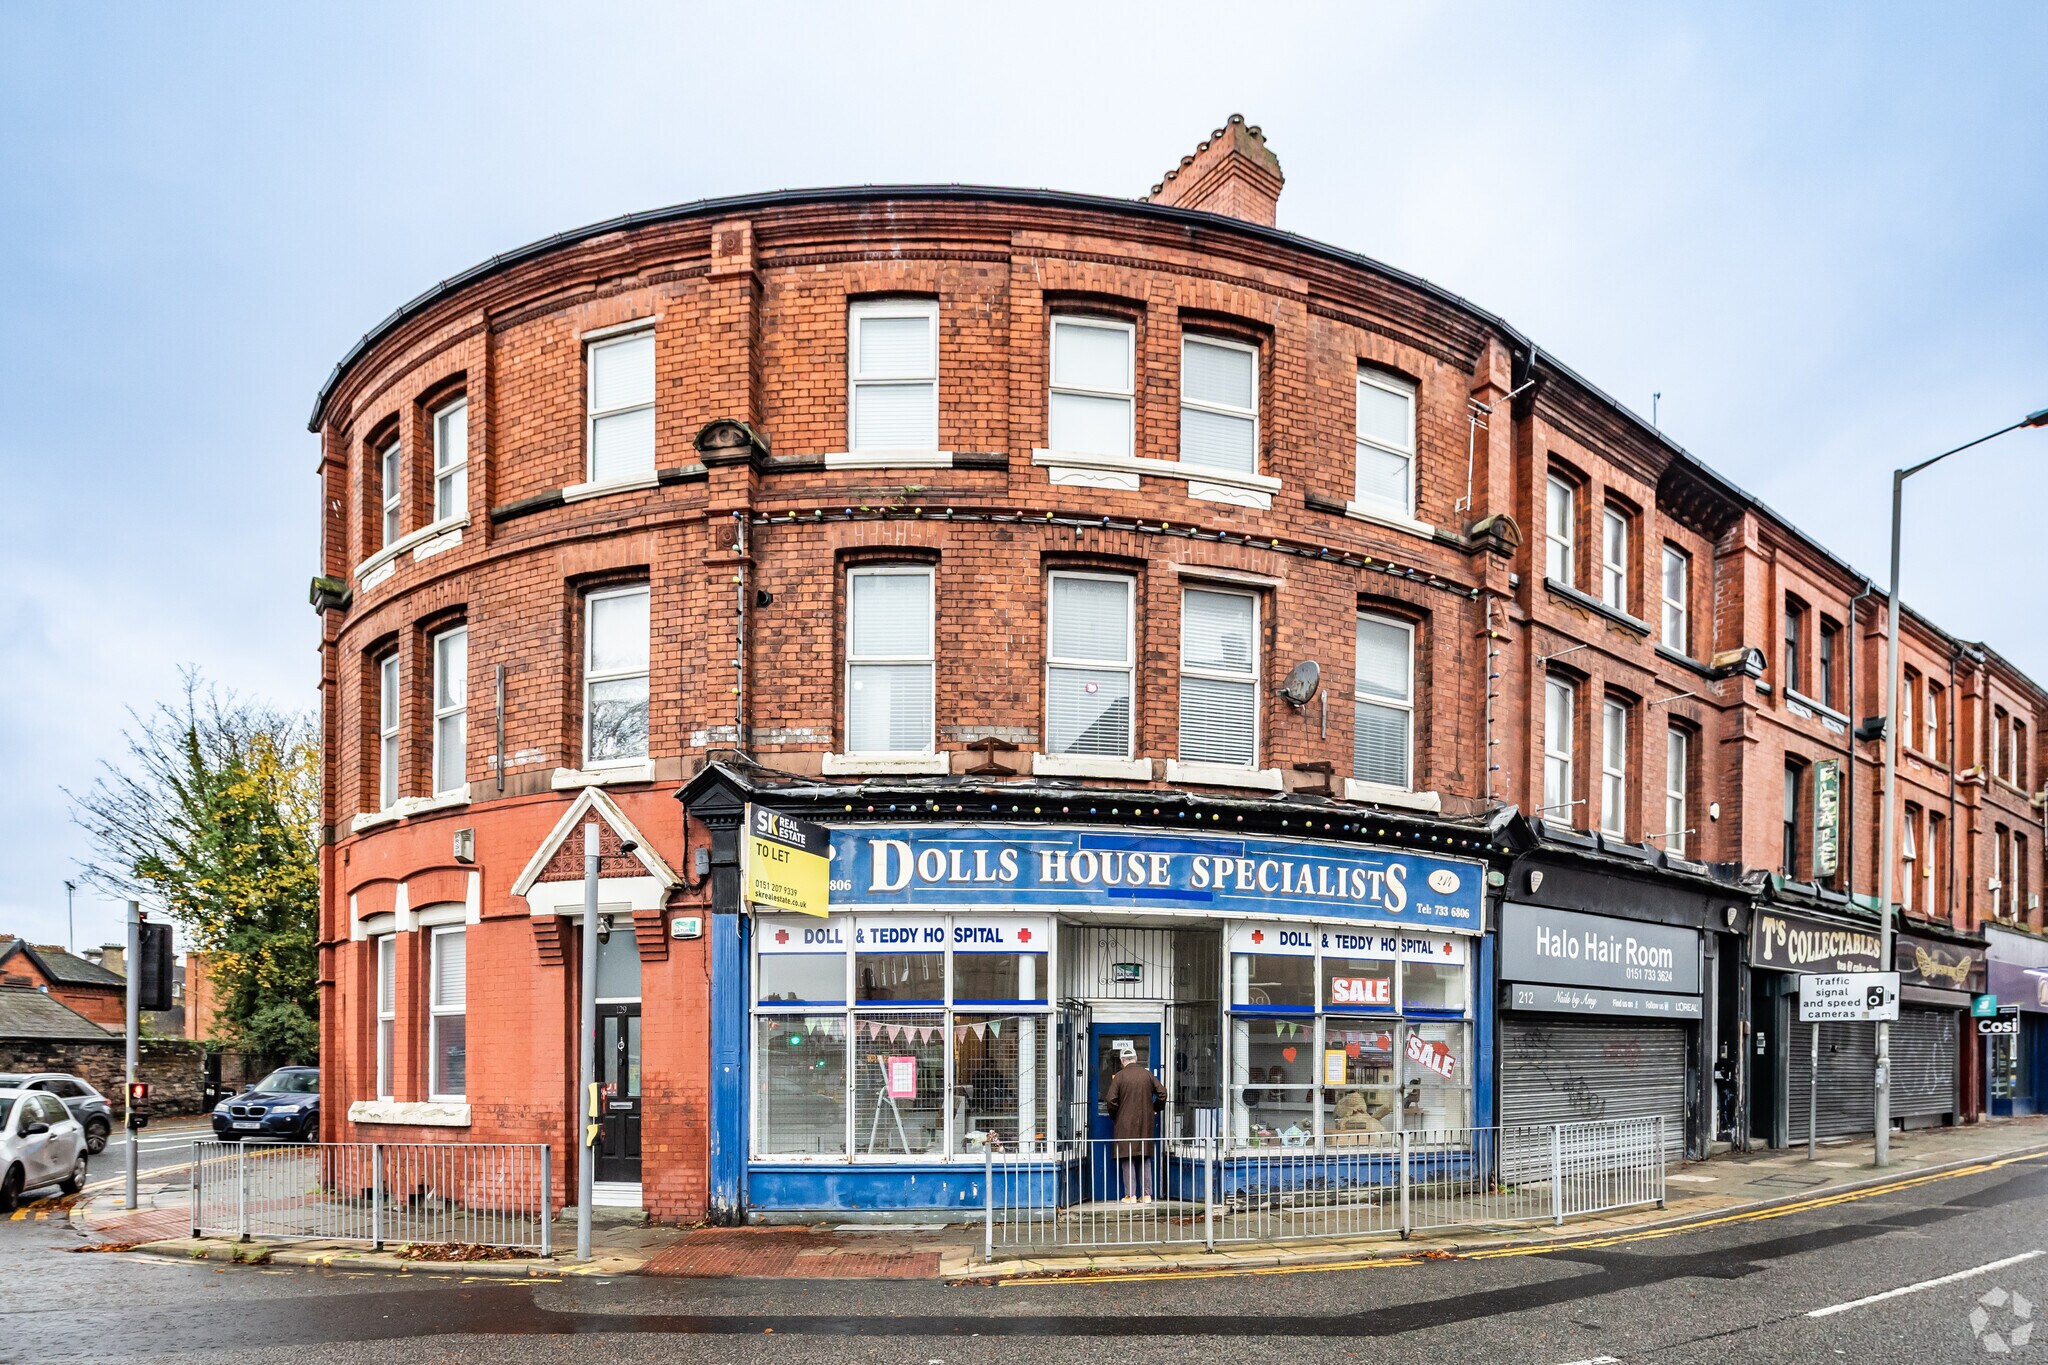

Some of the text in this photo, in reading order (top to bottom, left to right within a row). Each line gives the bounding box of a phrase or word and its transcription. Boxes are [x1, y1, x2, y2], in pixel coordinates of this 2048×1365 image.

[757, 811, 779, 836] SK
[780, 817, 799, 831] REAL
[779, 827, 805, 844] ESTATE
[756, 843, 790, 863] TO LET
[868, 839, 1407, 913] DOLLS HOUSE SPECIALISTS
[755, 880, 798, 897] 0151 207 9339
[755, 891, 807, 908] skrealestate.co.uk
[1416, 902, 1470, 919] Tel: 733 6806
[804, 929, 843, 944] DOLL
[856, 929, 865, 943] &
[870, 928, 918, 943] TEDDY
[1280, 931, 1312, 947] DOLL
[1321, 934, 1329, 948] &
[1335, 934, 1374, 950] TEDDY
[1536, 925, 1673, 968] Halo Hair Room
[1788, 929, 1880, 964] COLLECTABLES
[1626, 967, 1673, 982] 0151 733 3624
[1815, 977, 1850, 985] Traffic
[1334, 979, 1389, 1002] SALE
[1519, 991, 1534, 1004] 212
[1816, 988, 1848, 997] signal
[616, 1005, 627, 1014] 129
[1827, 999, 1860, 1008] speed
[1978, 1017, 2017, 1033] Cosi
[1408, 1036, 1455, 1079] SALE
